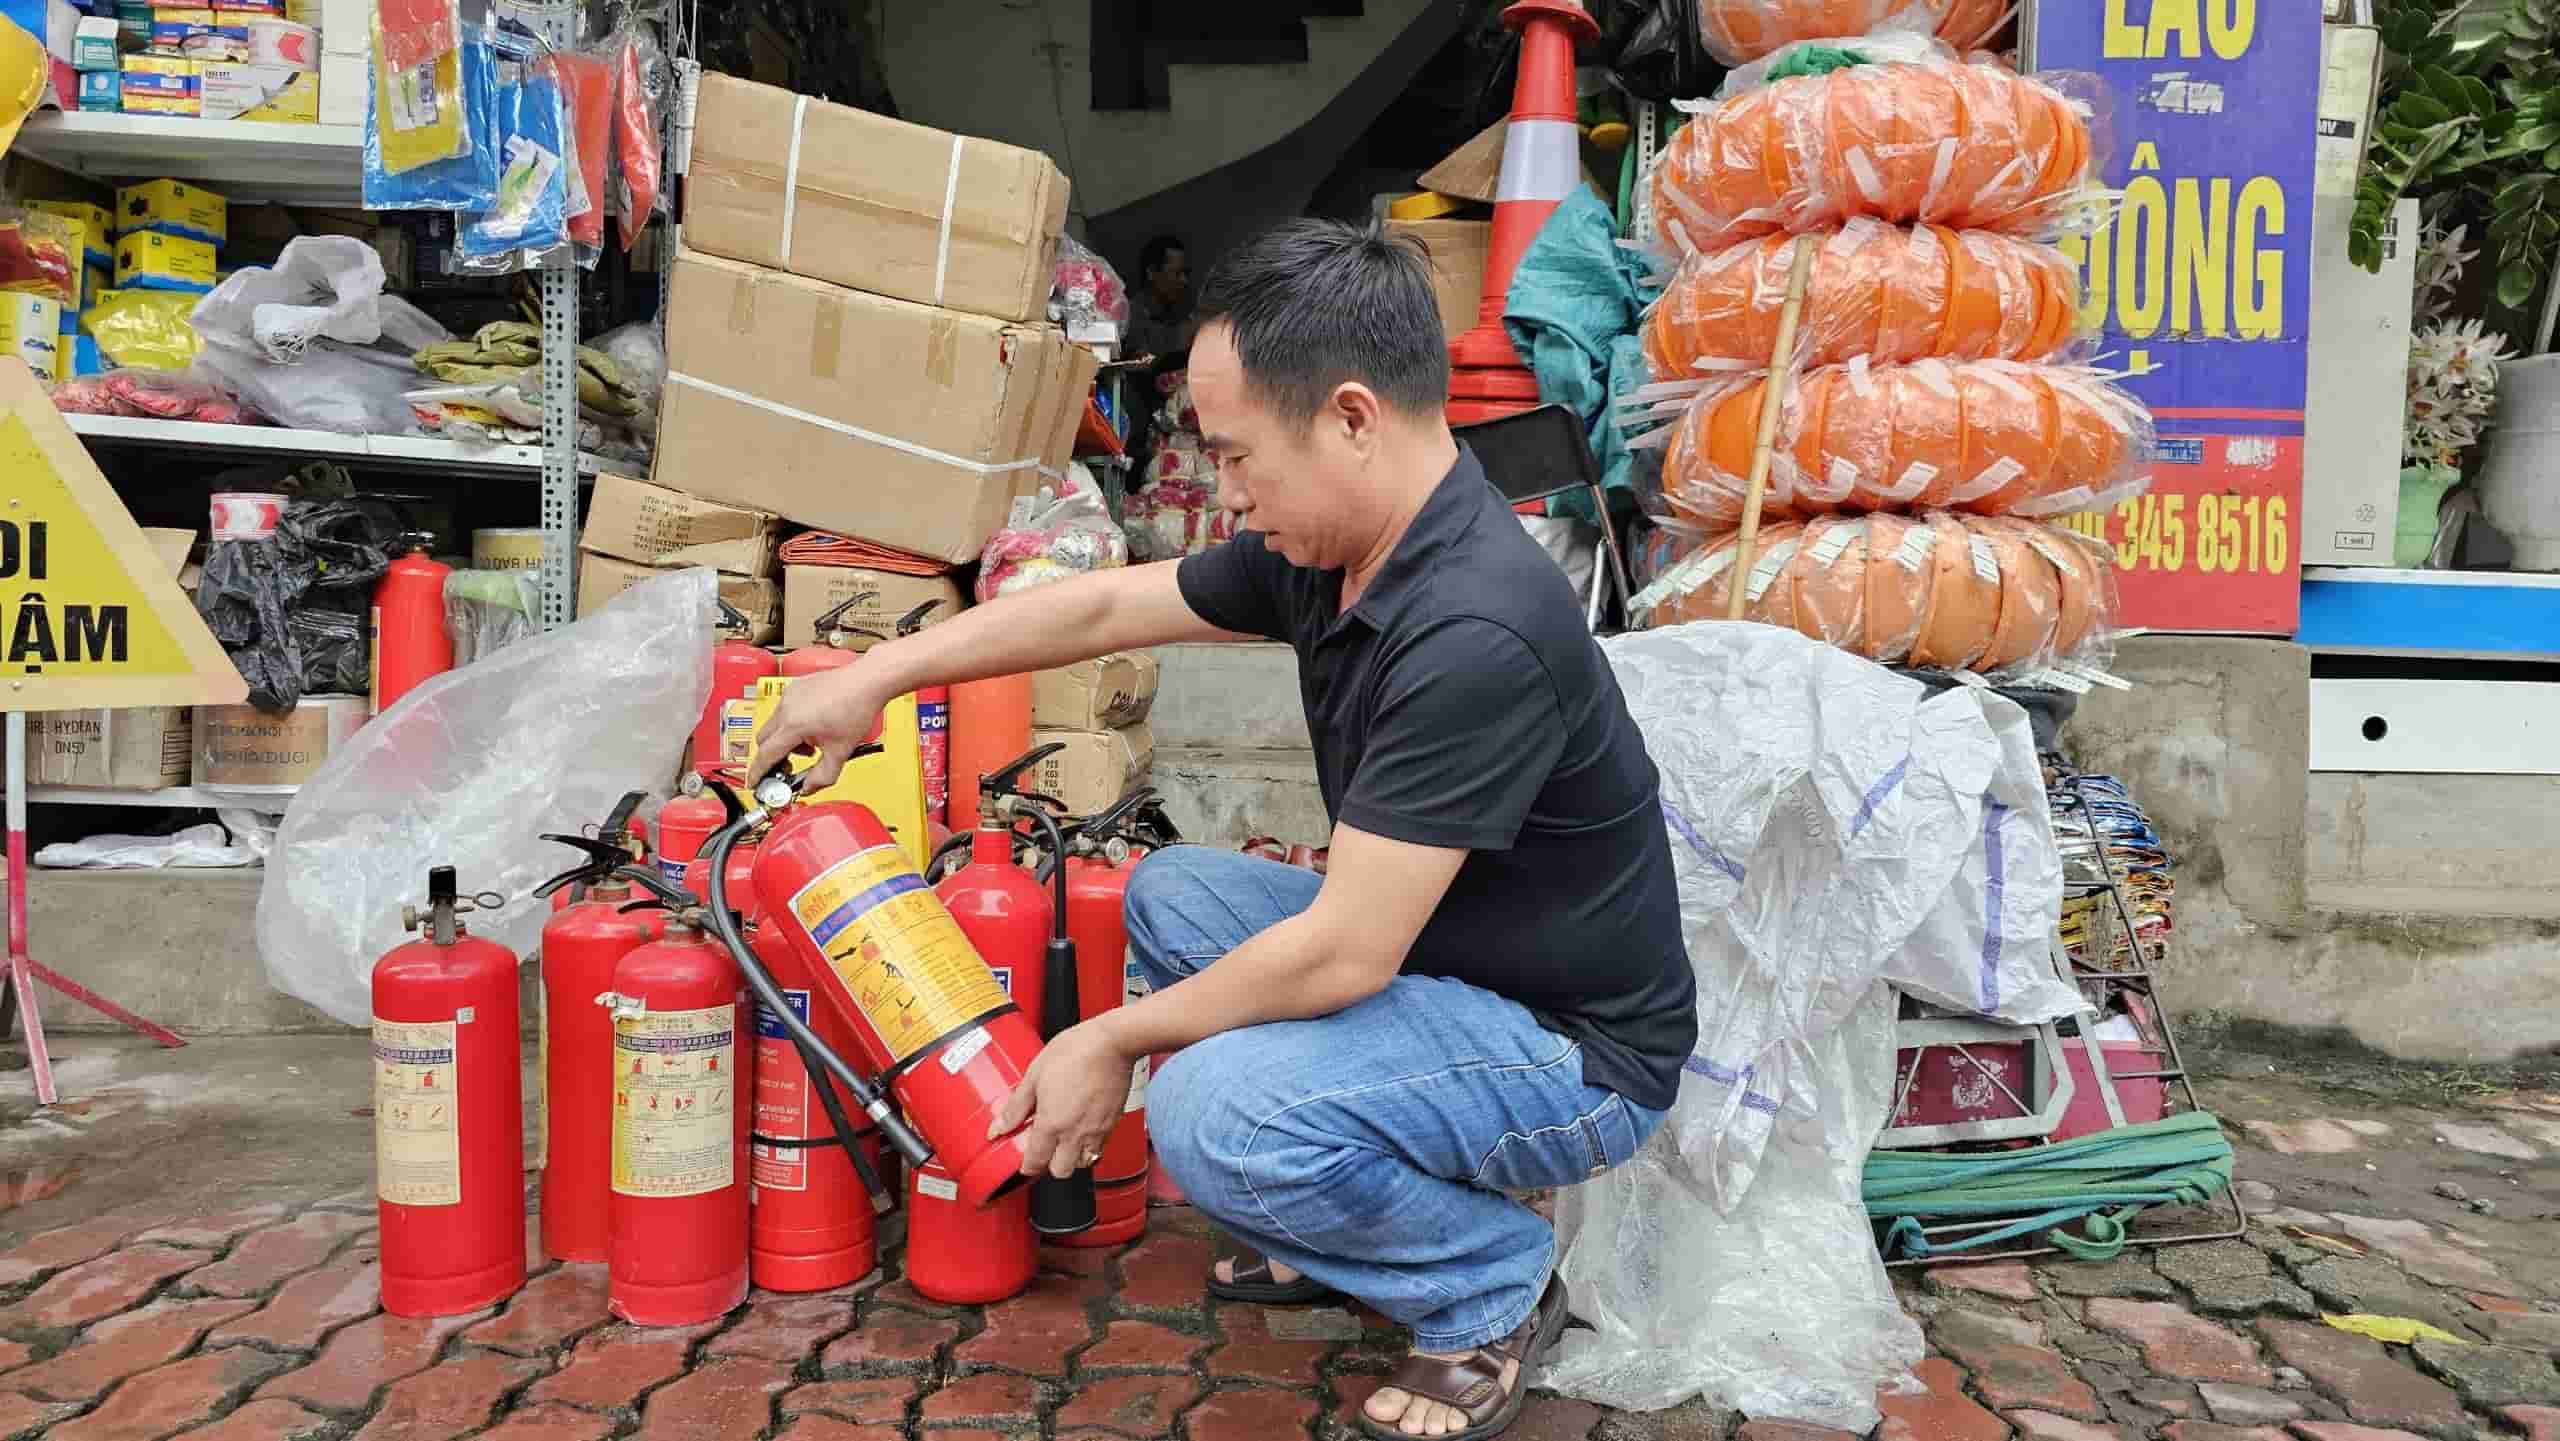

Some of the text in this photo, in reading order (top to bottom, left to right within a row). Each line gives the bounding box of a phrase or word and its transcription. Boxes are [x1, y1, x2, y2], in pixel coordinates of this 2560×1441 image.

[2117, 494, 2288, 574] 345 8516
[0, 592, 128, 674] ẬM
